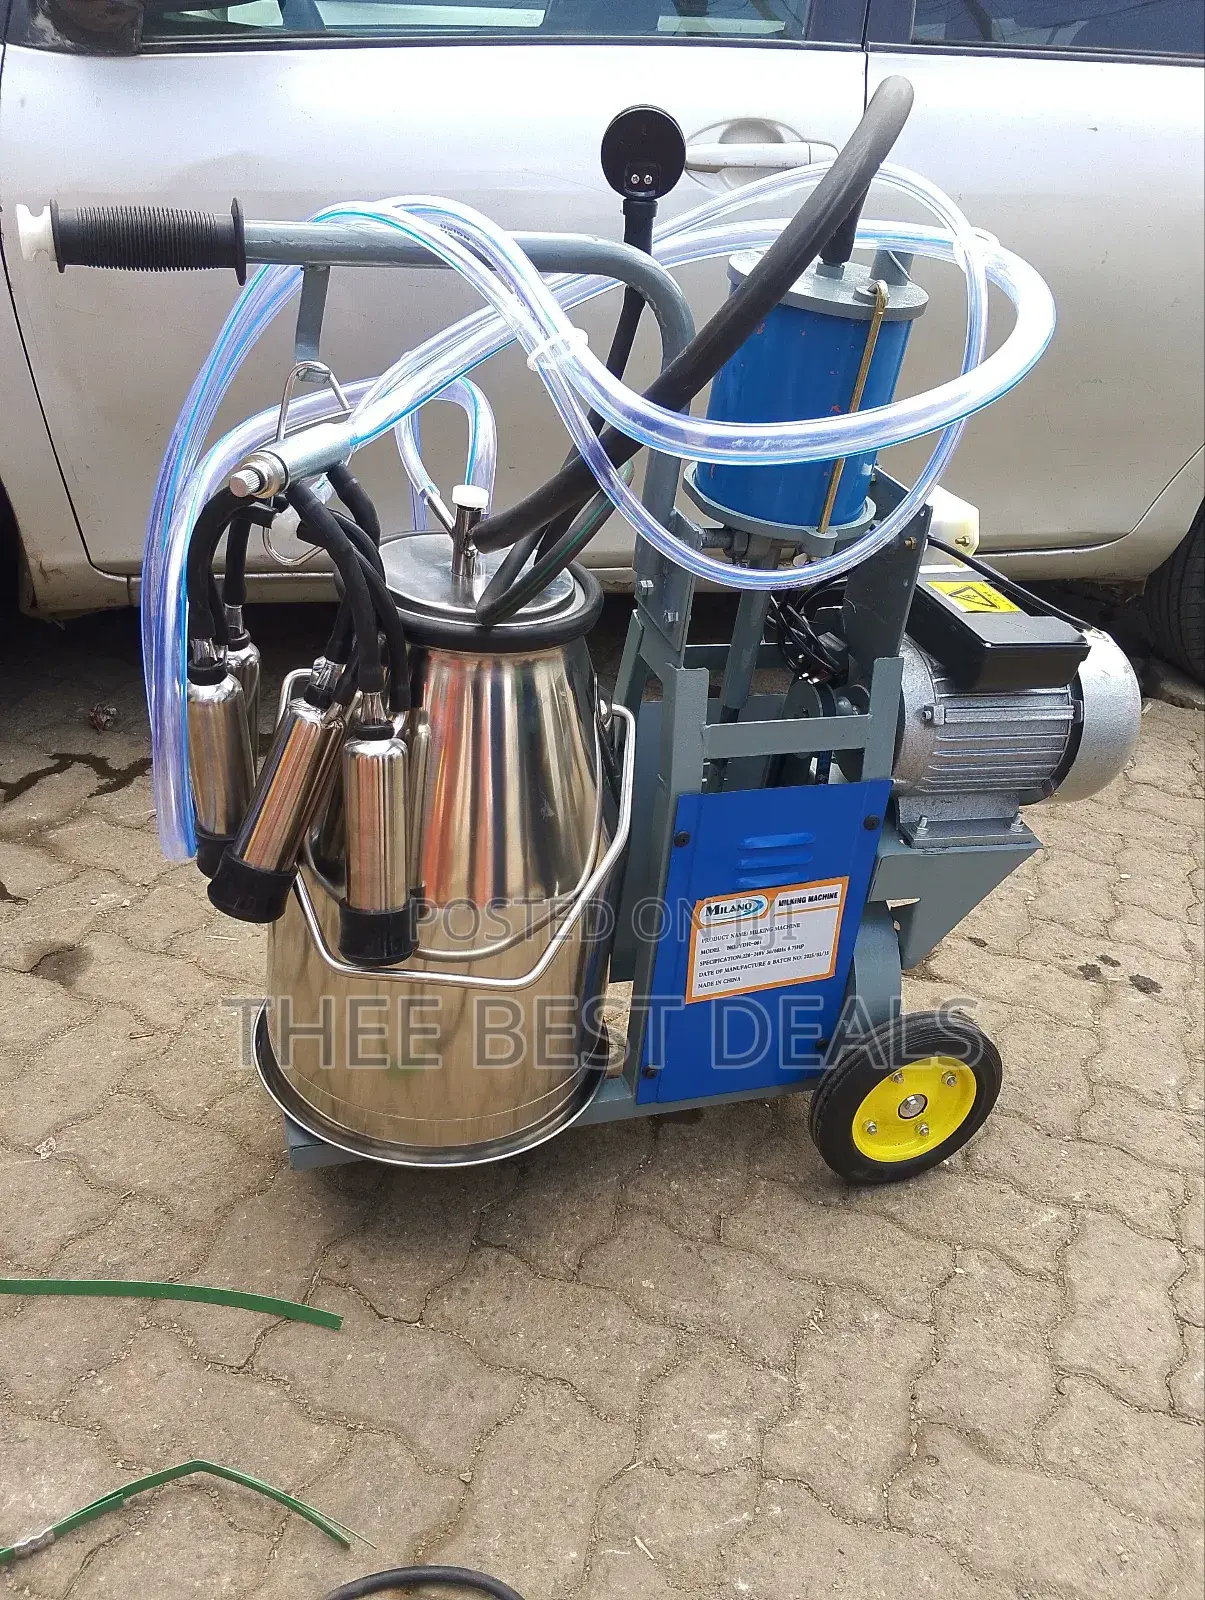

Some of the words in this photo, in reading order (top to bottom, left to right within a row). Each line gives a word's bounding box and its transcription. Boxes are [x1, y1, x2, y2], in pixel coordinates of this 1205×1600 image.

[778, 896, 806, 907] MILKING
[807, 891, 839, 902] MACHINE
[705, 901, 752, 917] MILANO
[701, 934, 730, 944] PRODUCT
[749, 927, 774, 936] MILKING
[774, 922, 801, 932] MACHINE
[700, 947, 720, 956] MODEL
[698, 969, 714, 978] DATE
[715, 967, 723, 975] OF
[724, 960, 766, 974] MANUFACTURE
[772, 957, 792, 965] BATCH
[698, 980, 714, 989] MADE
[715, 979, 722, 987] IN
[722, 976, 741, 985] CHINA
